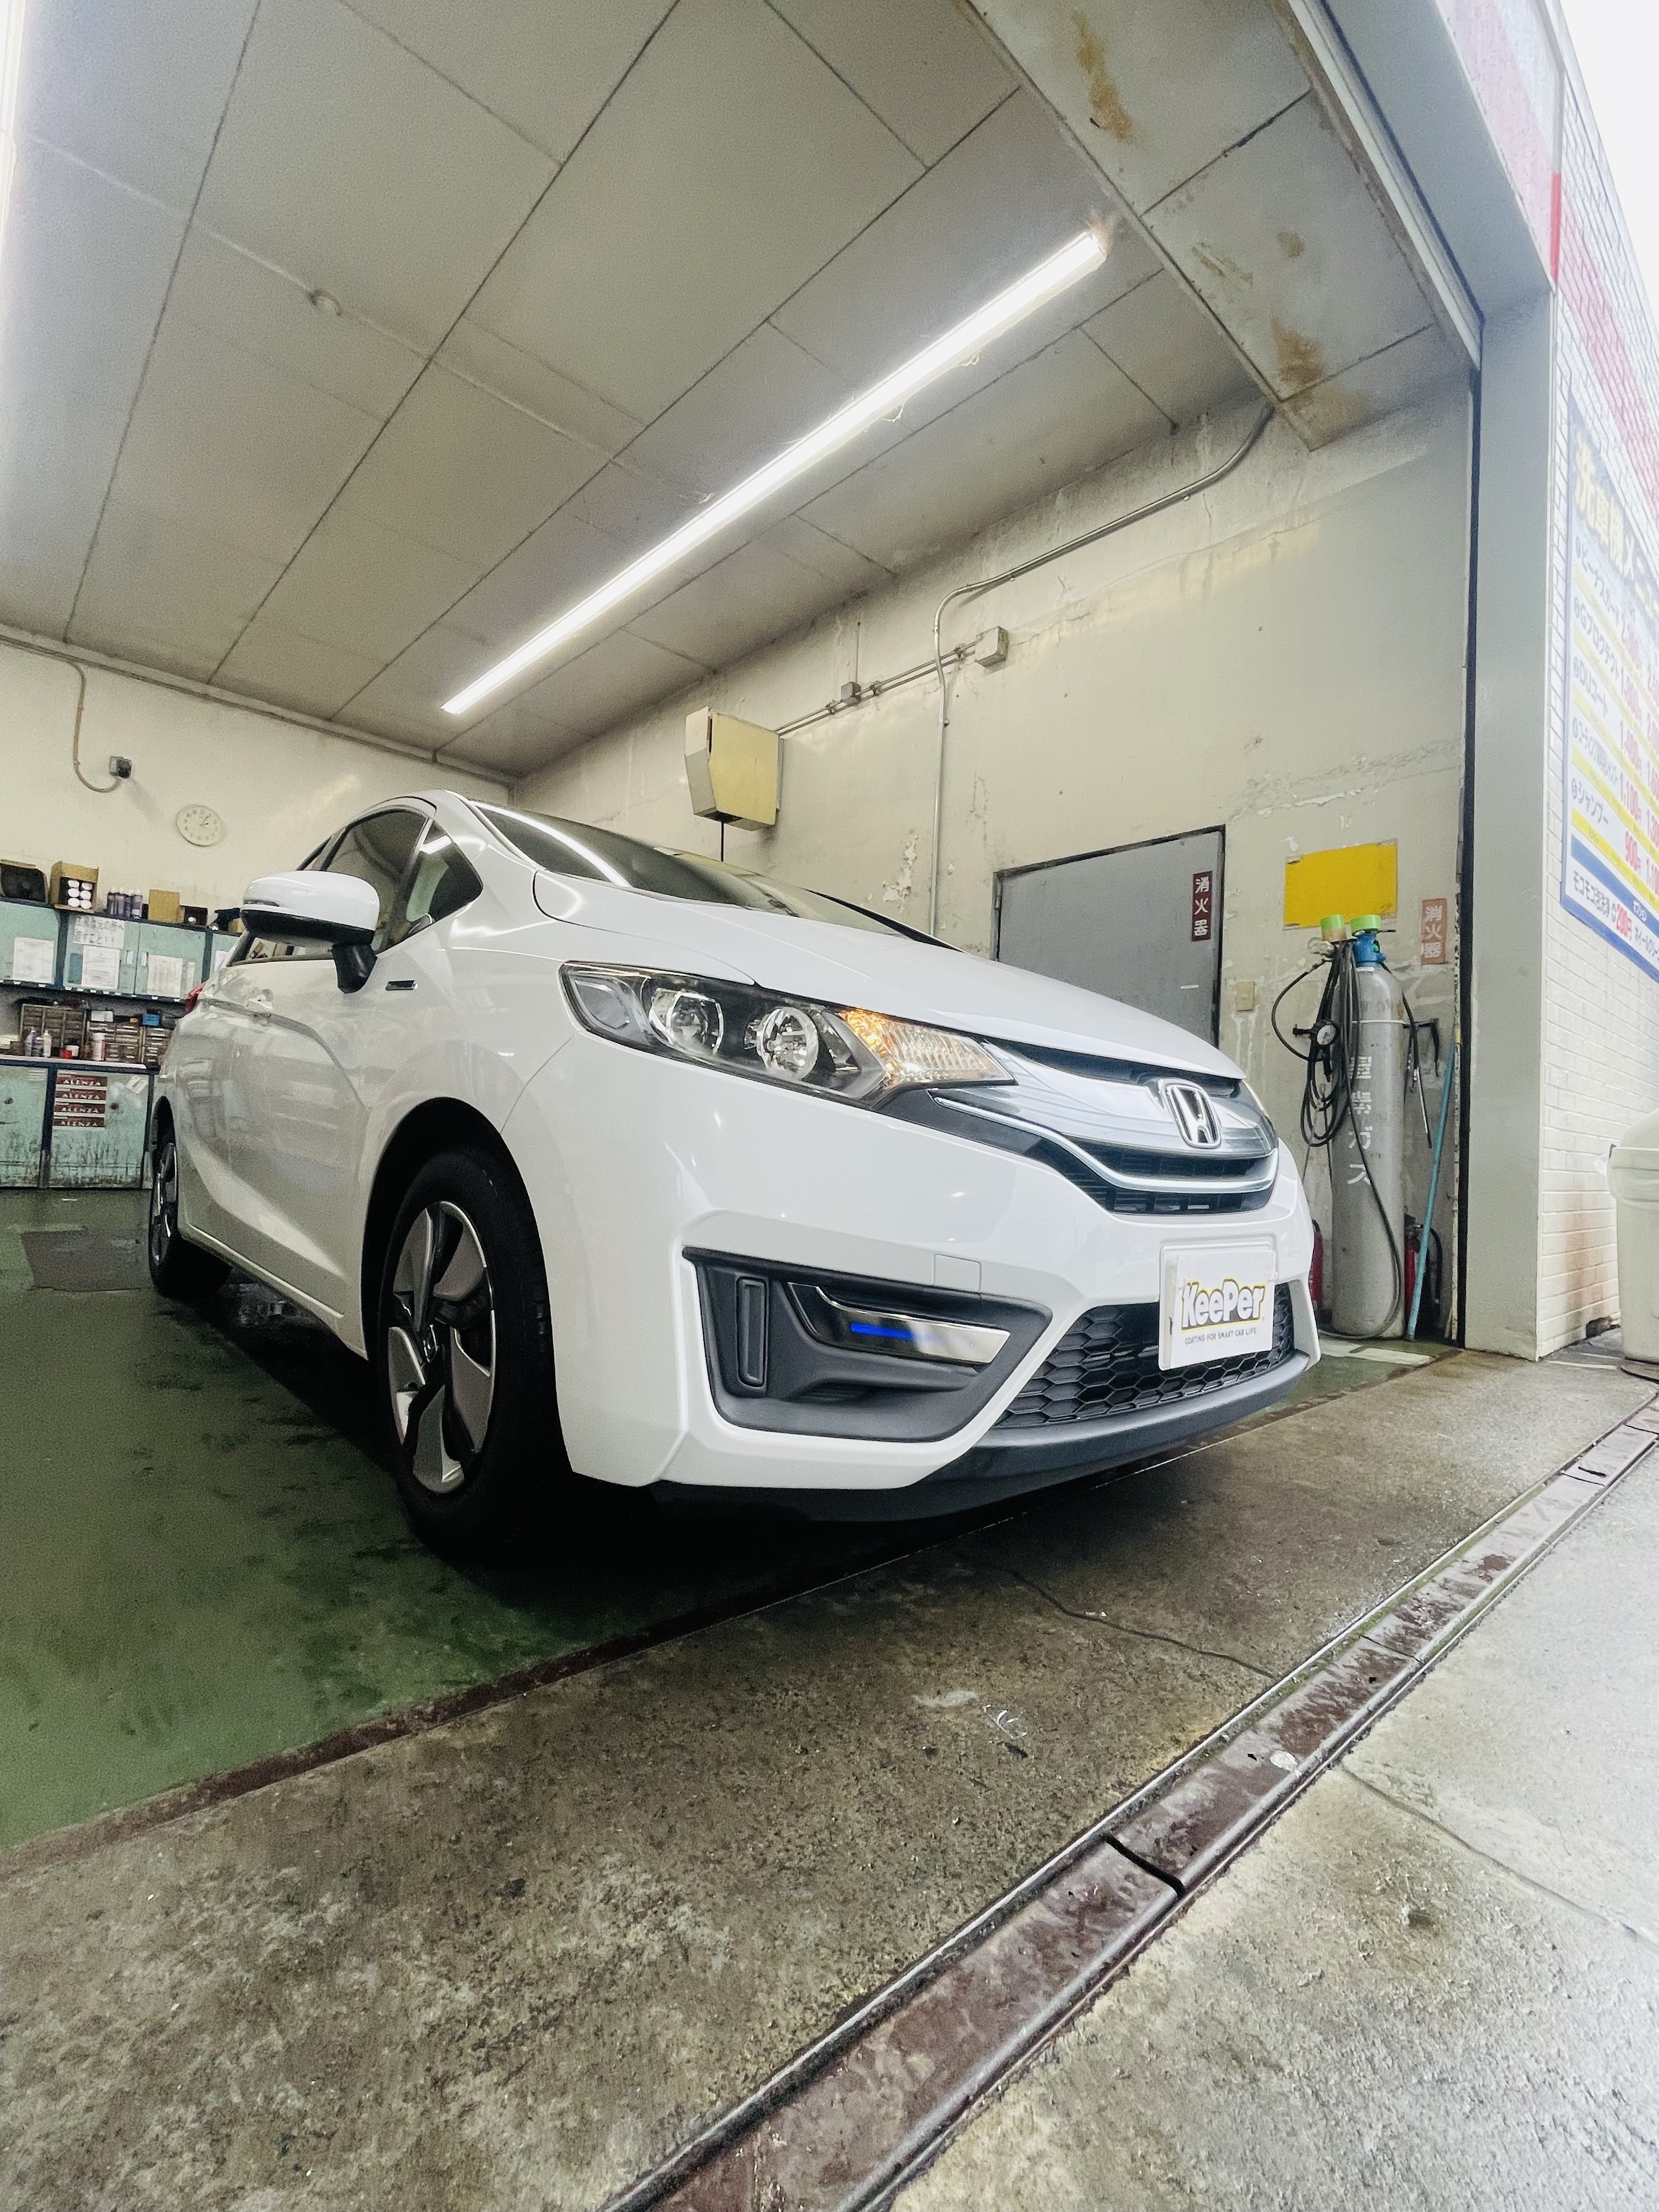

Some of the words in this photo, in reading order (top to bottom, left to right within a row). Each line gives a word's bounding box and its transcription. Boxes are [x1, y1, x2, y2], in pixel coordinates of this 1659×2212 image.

[1578, 781, 1609, 825] シャンプー
[1624, 830, 1641, 875] 900円
[1194, 876, 1209, 936] 消火器
[1424, 905, 1442, 958] 消火器
[1182, 1279, 1265, 1330] KeePer
[1185, 1335, 1205, 1345] COATING
[1218, 1330, 1234, 1339] SMART
